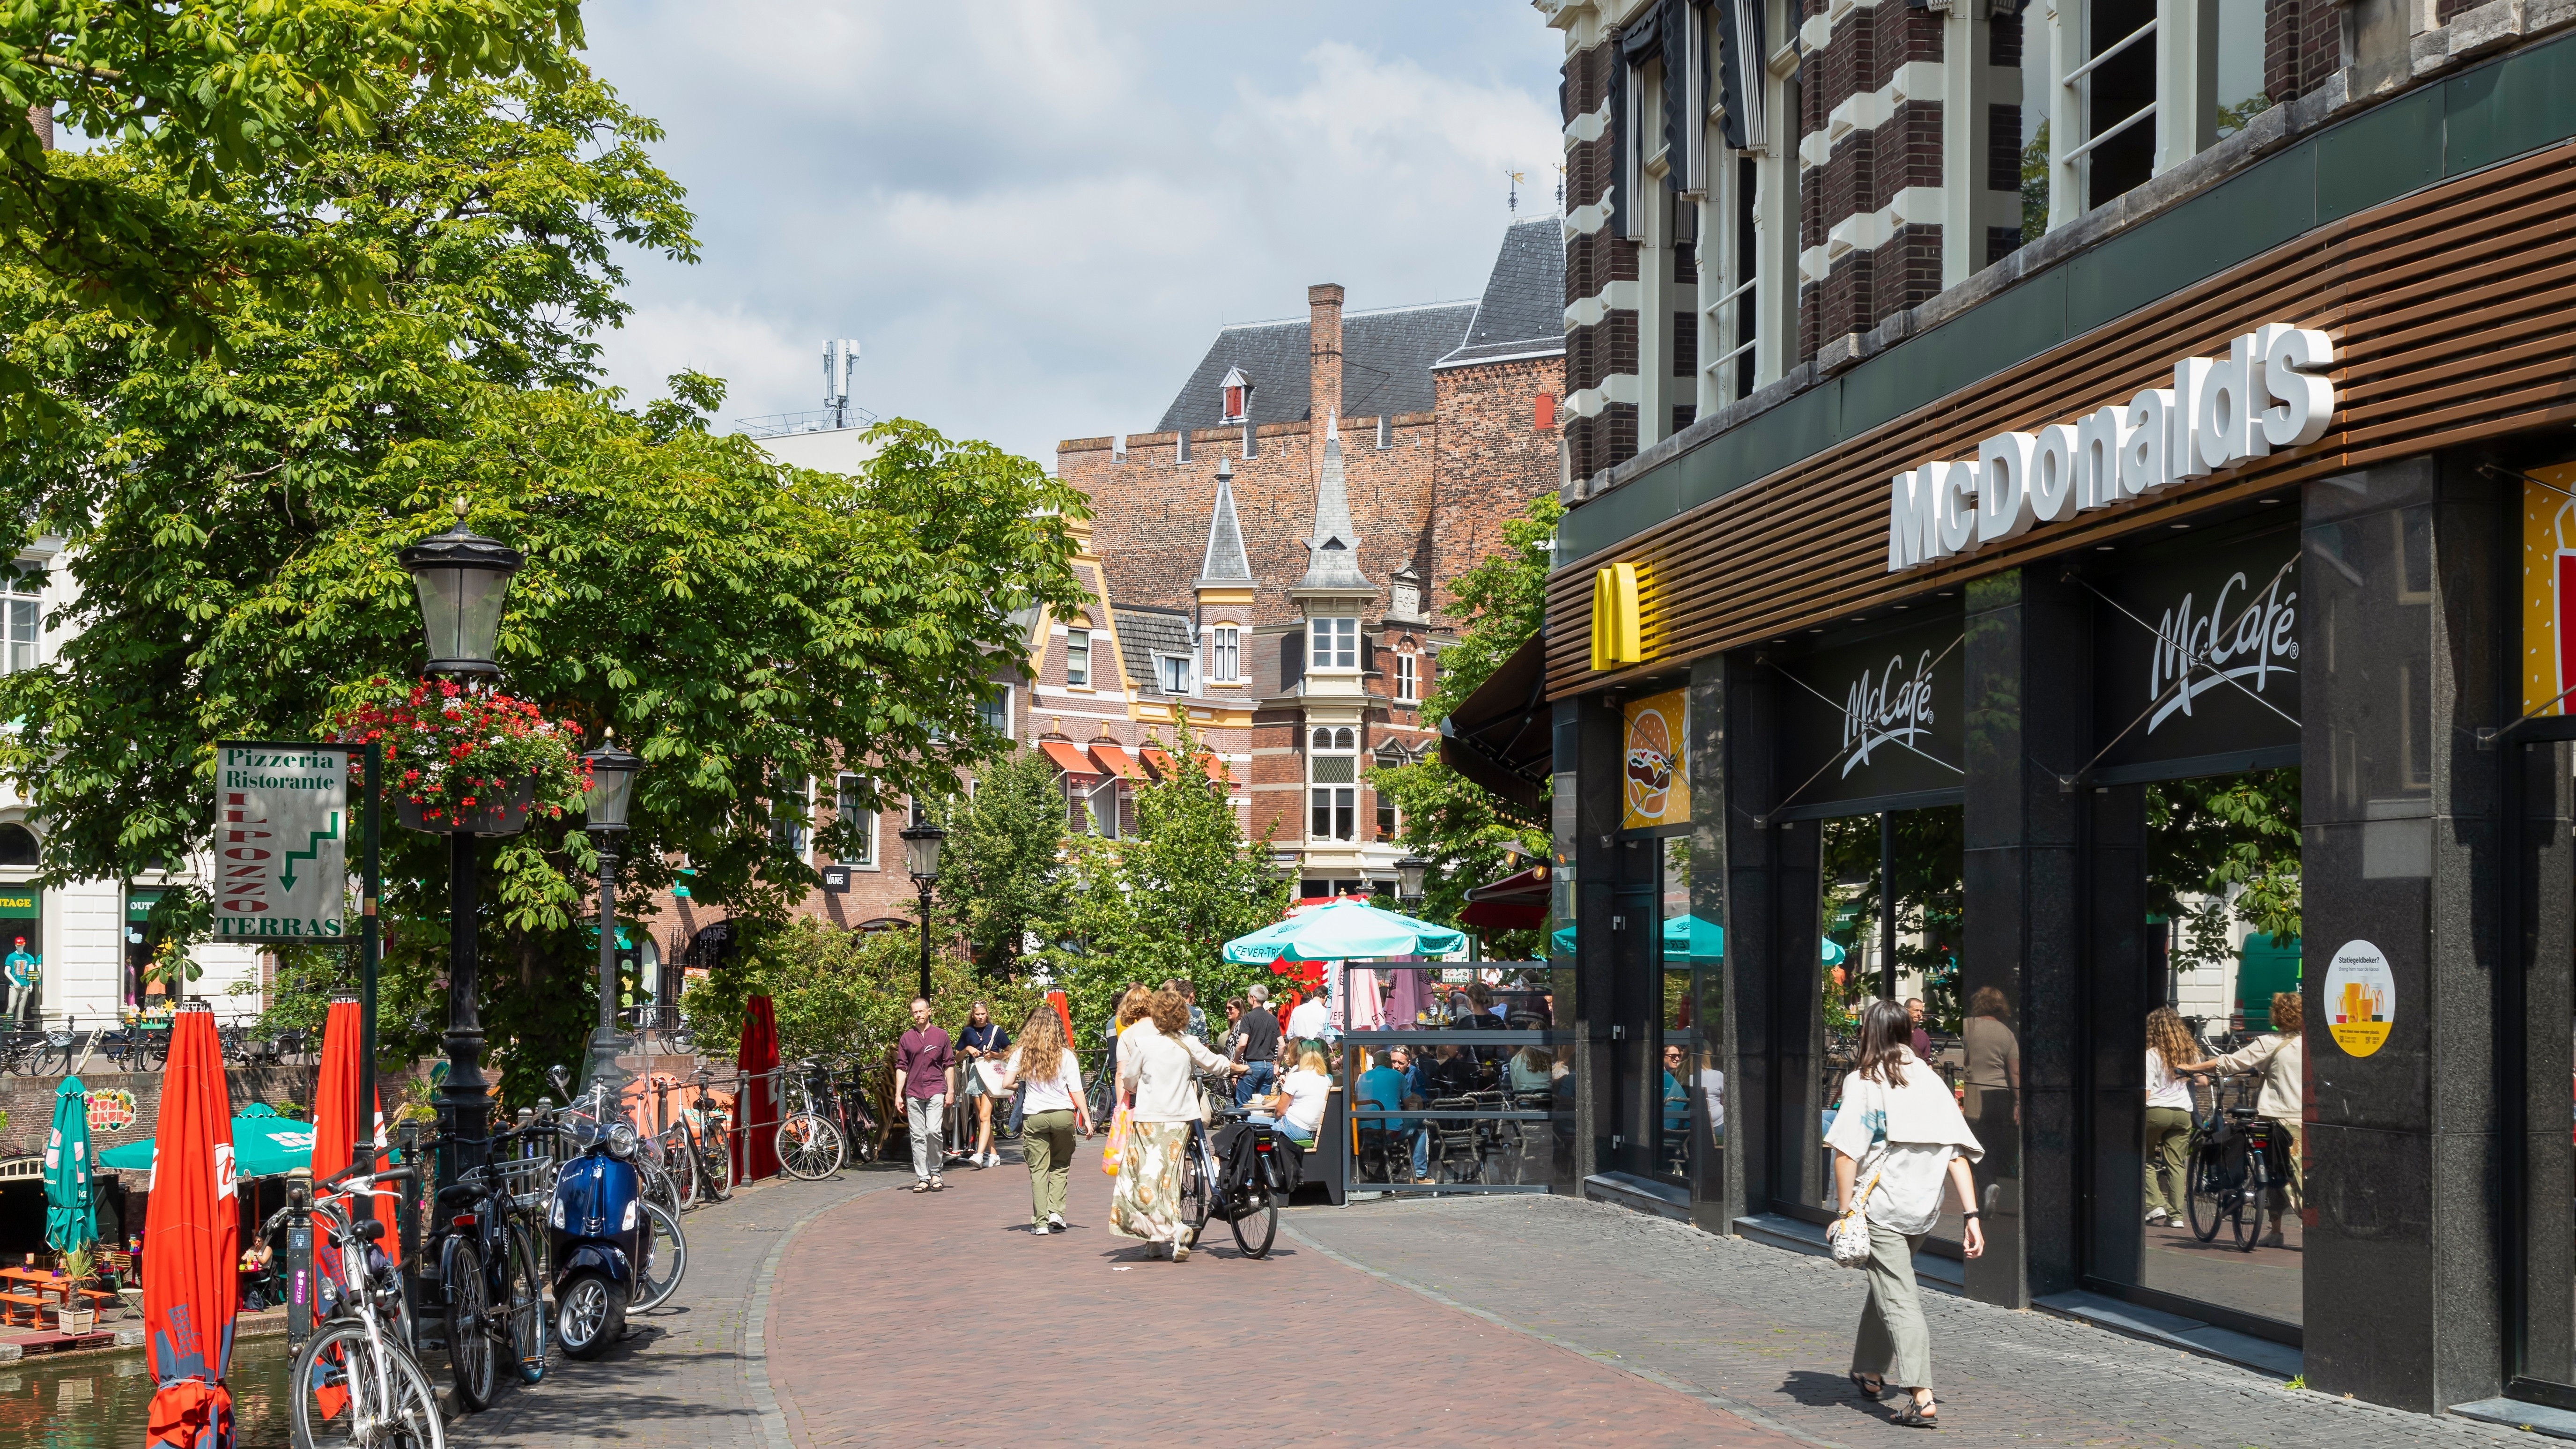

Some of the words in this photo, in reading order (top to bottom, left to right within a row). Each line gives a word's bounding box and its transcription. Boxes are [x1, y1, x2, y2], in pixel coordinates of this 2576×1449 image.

[1888, 323, 2334, 572] McDonald's
[2151, 562, 2297, 717] McCafé
[1843, 649, 1932, 765] McCafé
[226, 749, 334, 769] Pizzeria
[226, 770, 335, 790] Ristorante
[826, 873, 844, 885] VANS
[130, 902, 155, 910] OUT
[216, 917, 341, 937] TERRAS
[699, 924, 727, 940] VANS
[1421, 937, 1458, 948] FEVER-TREE
[1234, 946, 1282, 958] FEVER-TRE
[2339, 956, 2380, 965] Statiegeldbeker?
[91, 1101, 117, 1111] RUM
[90, 1111, 124, 1123] CLUB
